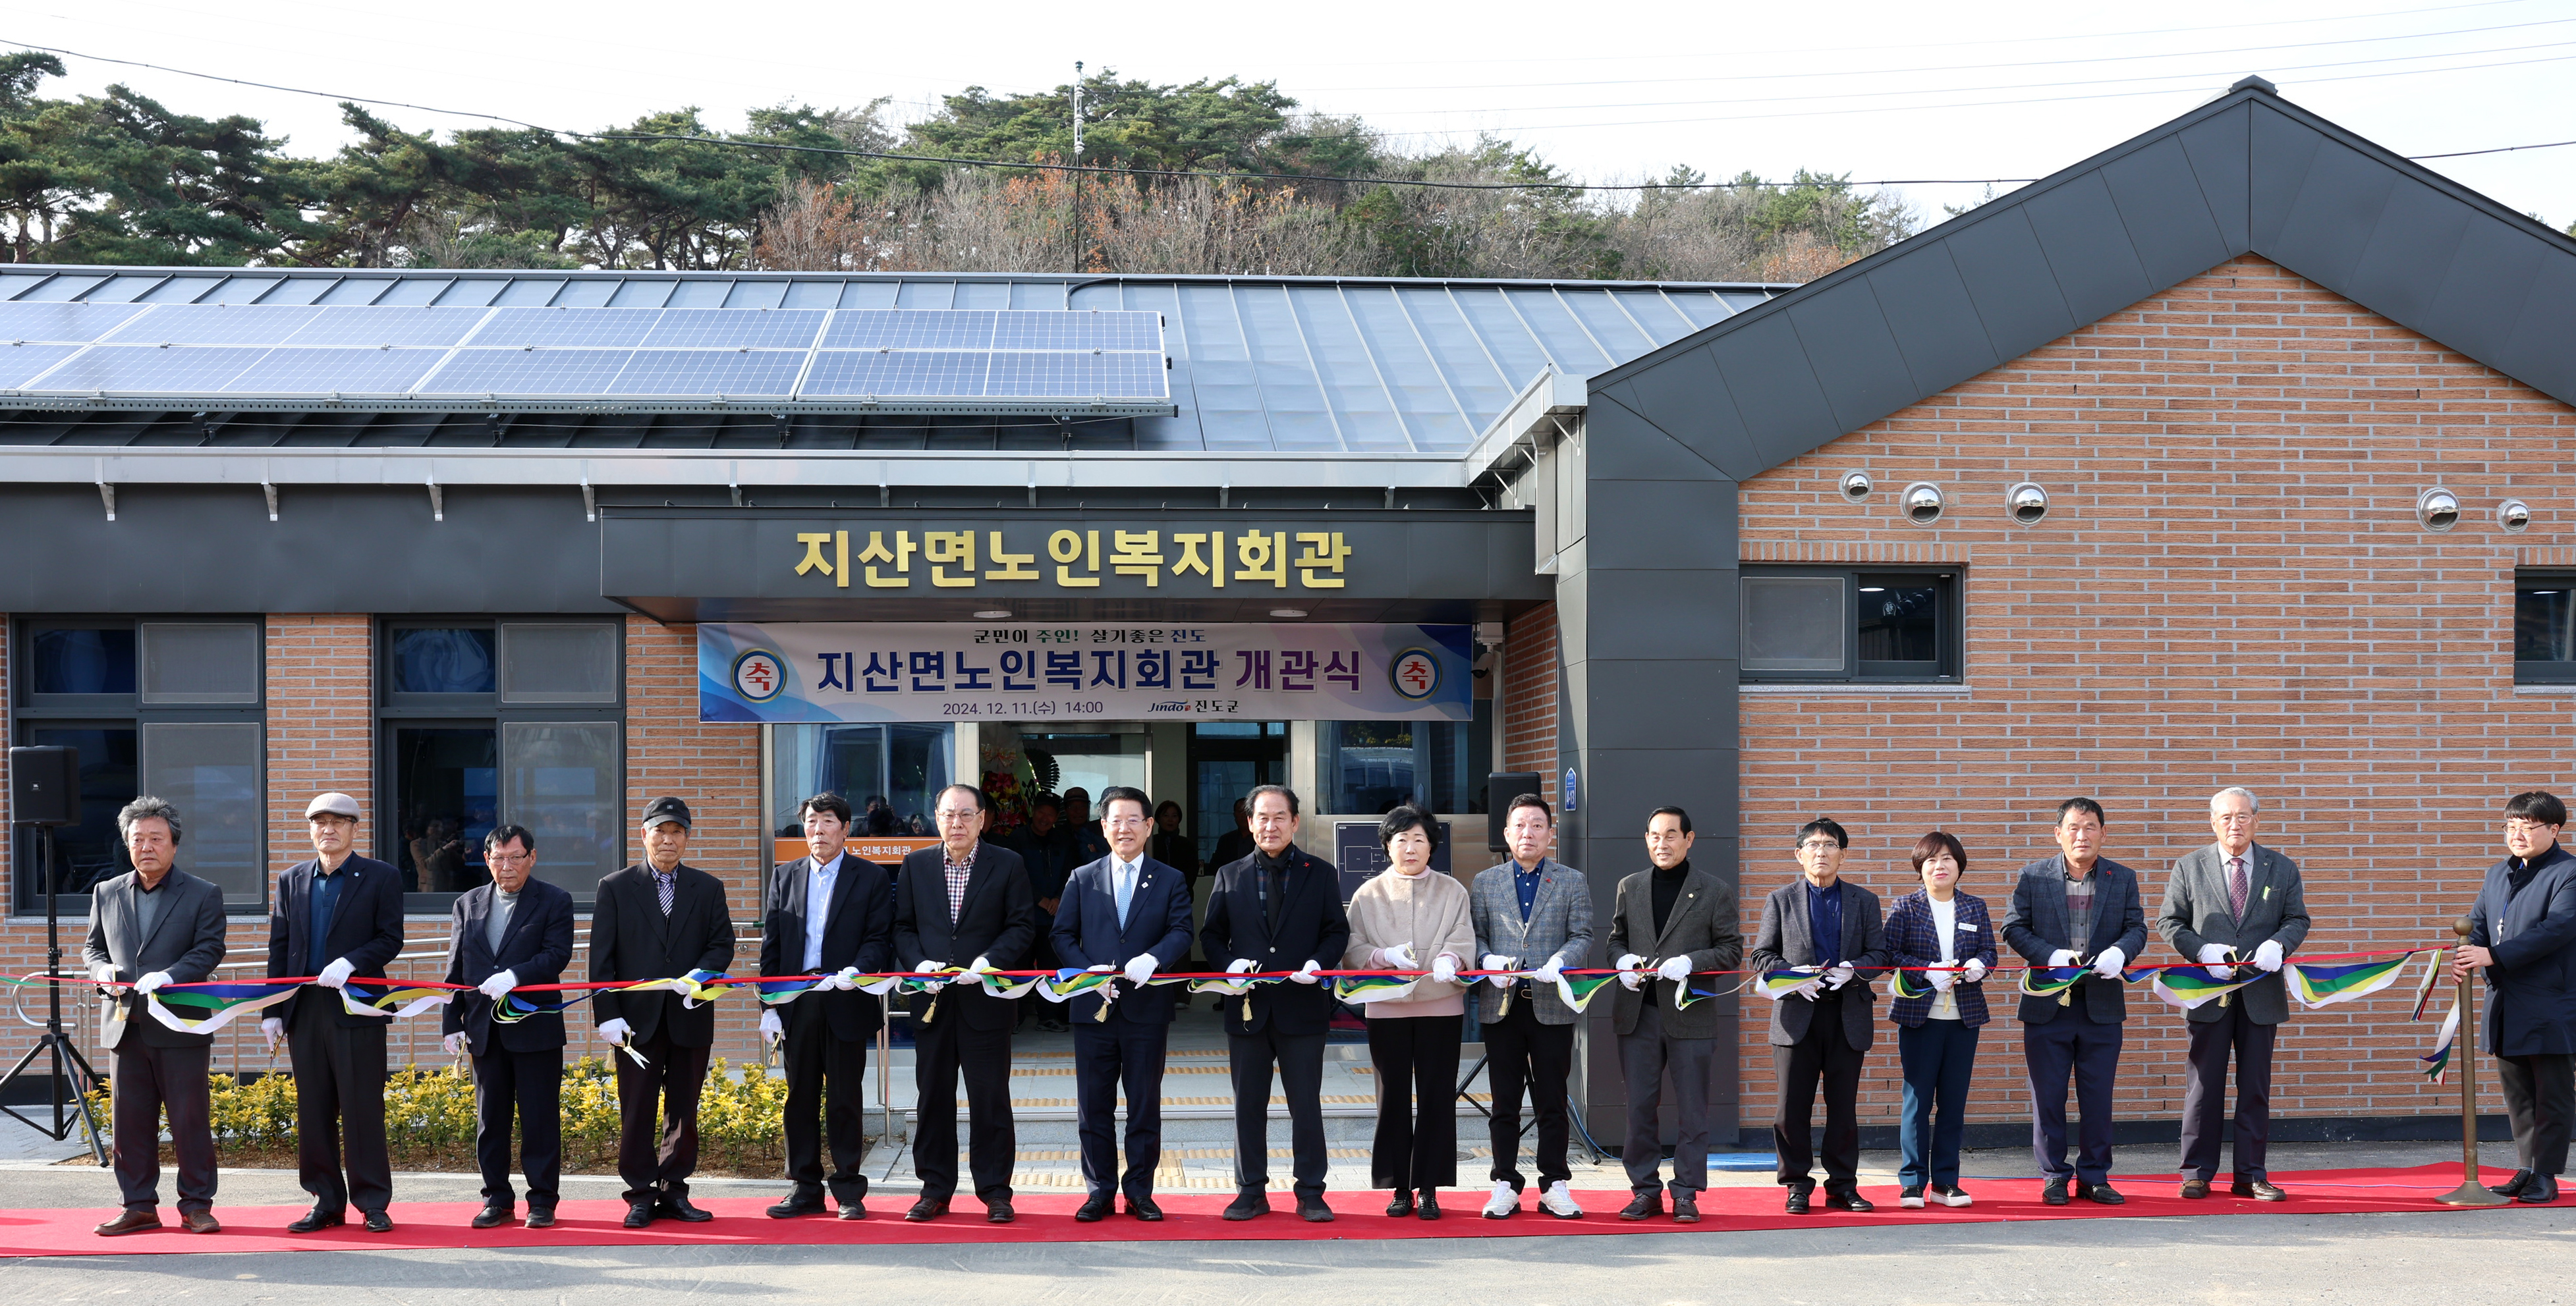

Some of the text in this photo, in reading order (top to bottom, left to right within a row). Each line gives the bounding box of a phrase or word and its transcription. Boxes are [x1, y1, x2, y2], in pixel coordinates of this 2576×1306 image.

[795, 529, 1352, 588] 지산면노인복지회관
[974, 629, 1206, 643] 군민이 주인! 살기좋은 진도
[744, 662, 773, 692] 축
[817, 648, 1361, 692] 지산면노인복지회관 개관식
[1402, 661, 1428, 690] 축
[943, 700, 1104, 715] 2024. 12. 11.(수) 14:00
[1194, 699, 1239, 713] 진도군
[851, 845, 912, 856] 노인복지회관
